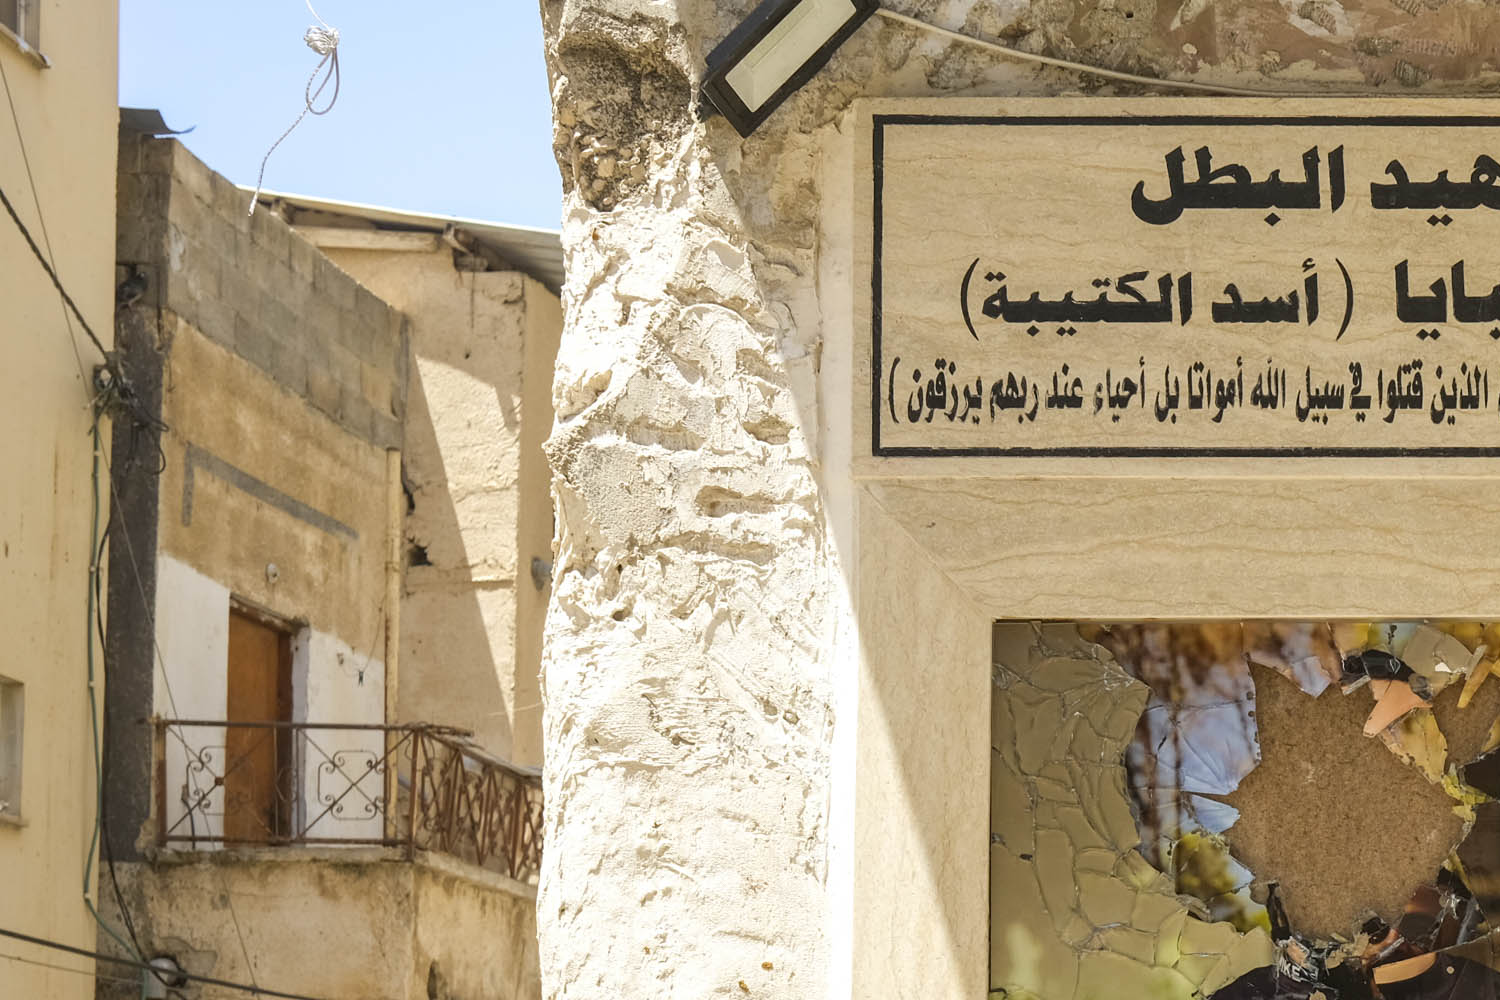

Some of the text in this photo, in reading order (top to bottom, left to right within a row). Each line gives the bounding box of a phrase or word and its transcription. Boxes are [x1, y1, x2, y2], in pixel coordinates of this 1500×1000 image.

[1130, 144, 1346, 227] البطل
[989, 370, 1039, 424] ربهم
[1045, 363, 1084, 410] عند
[1095, 355, 1146, 424] أحياء
[1154, 365, 1180, 425] بل
[1250, 357, 1287, 411] الله
[1295, 365, 1345, 425] سبيل
[1377, 357, 1424, 425] قتلوا
[1430, 361, 1490, 426] الذين
